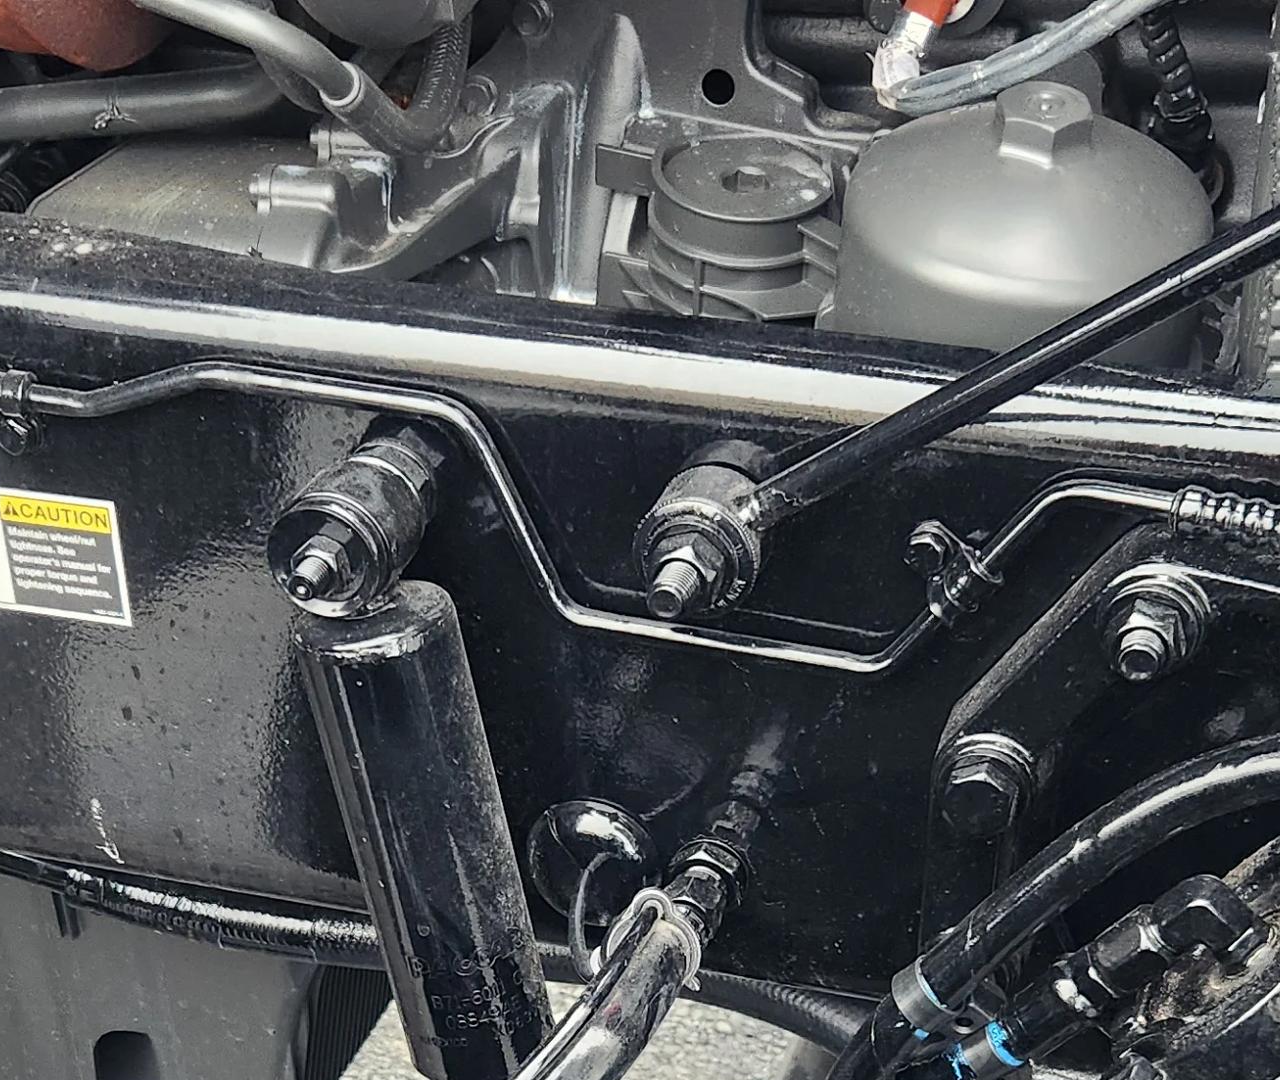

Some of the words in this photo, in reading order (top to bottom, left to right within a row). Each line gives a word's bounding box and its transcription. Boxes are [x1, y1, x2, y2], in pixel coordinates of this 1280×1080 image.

[20, 504, 107, 527] CAUTION
[7, 526, 47, 540] Maintain
[50, 532, 95, 546] wheel/nut
[9, 539, 55, 554] tightness.
[56, 547, 77, 556] See
[14, 566, 46, 578] proper
[48, 570, 78, 582] torque
[79, 575, 98, 584] and
[62, 560, 96, 571] manual
[97, 564, 112, 573] for
[16, 578, 63, 593] tightening
[65, 585, 112, 600] sequence.
